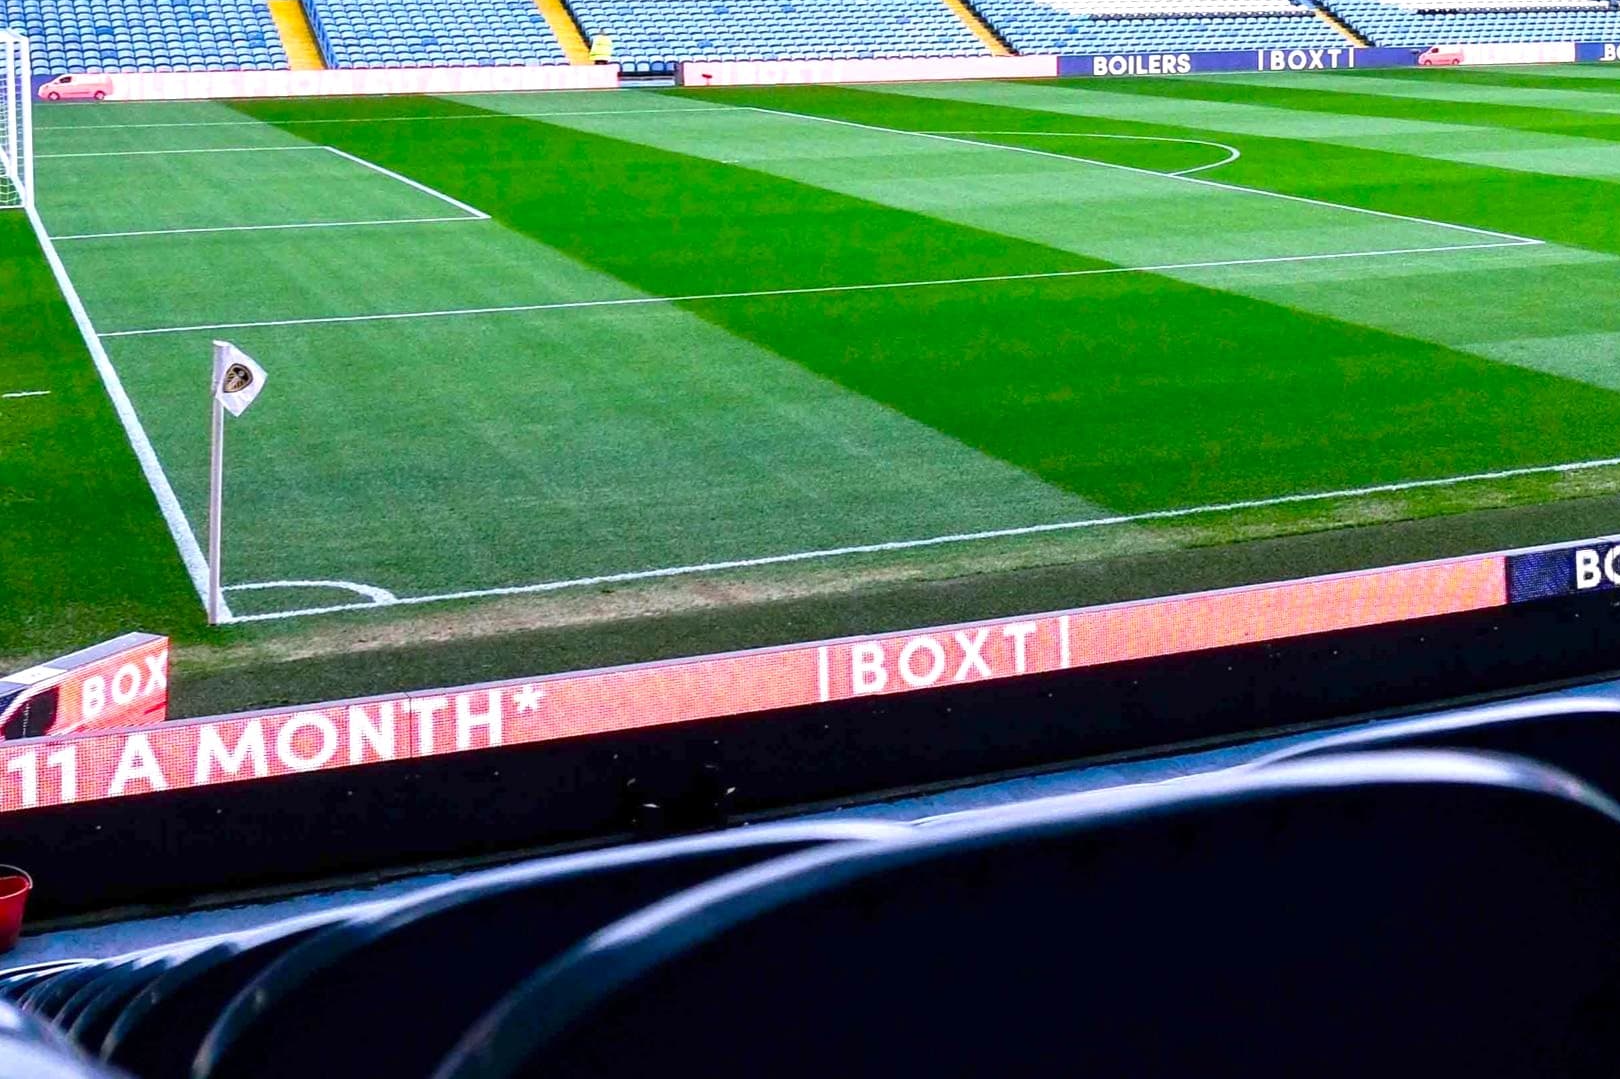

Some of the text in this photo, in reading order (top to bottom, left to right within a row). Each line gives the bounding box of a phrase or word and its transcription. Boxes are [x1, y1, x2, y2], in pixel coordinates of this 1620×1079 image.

[1093, 54, 1191, 76] BOILERS
[1271, 49, 1340, 71] BOXT
[81, 649, 168, 718] BOX
[852, 621, 1038, 694] BOXT
[7, 745, 77, 808] 11
[108, 731, 169, 796] A
